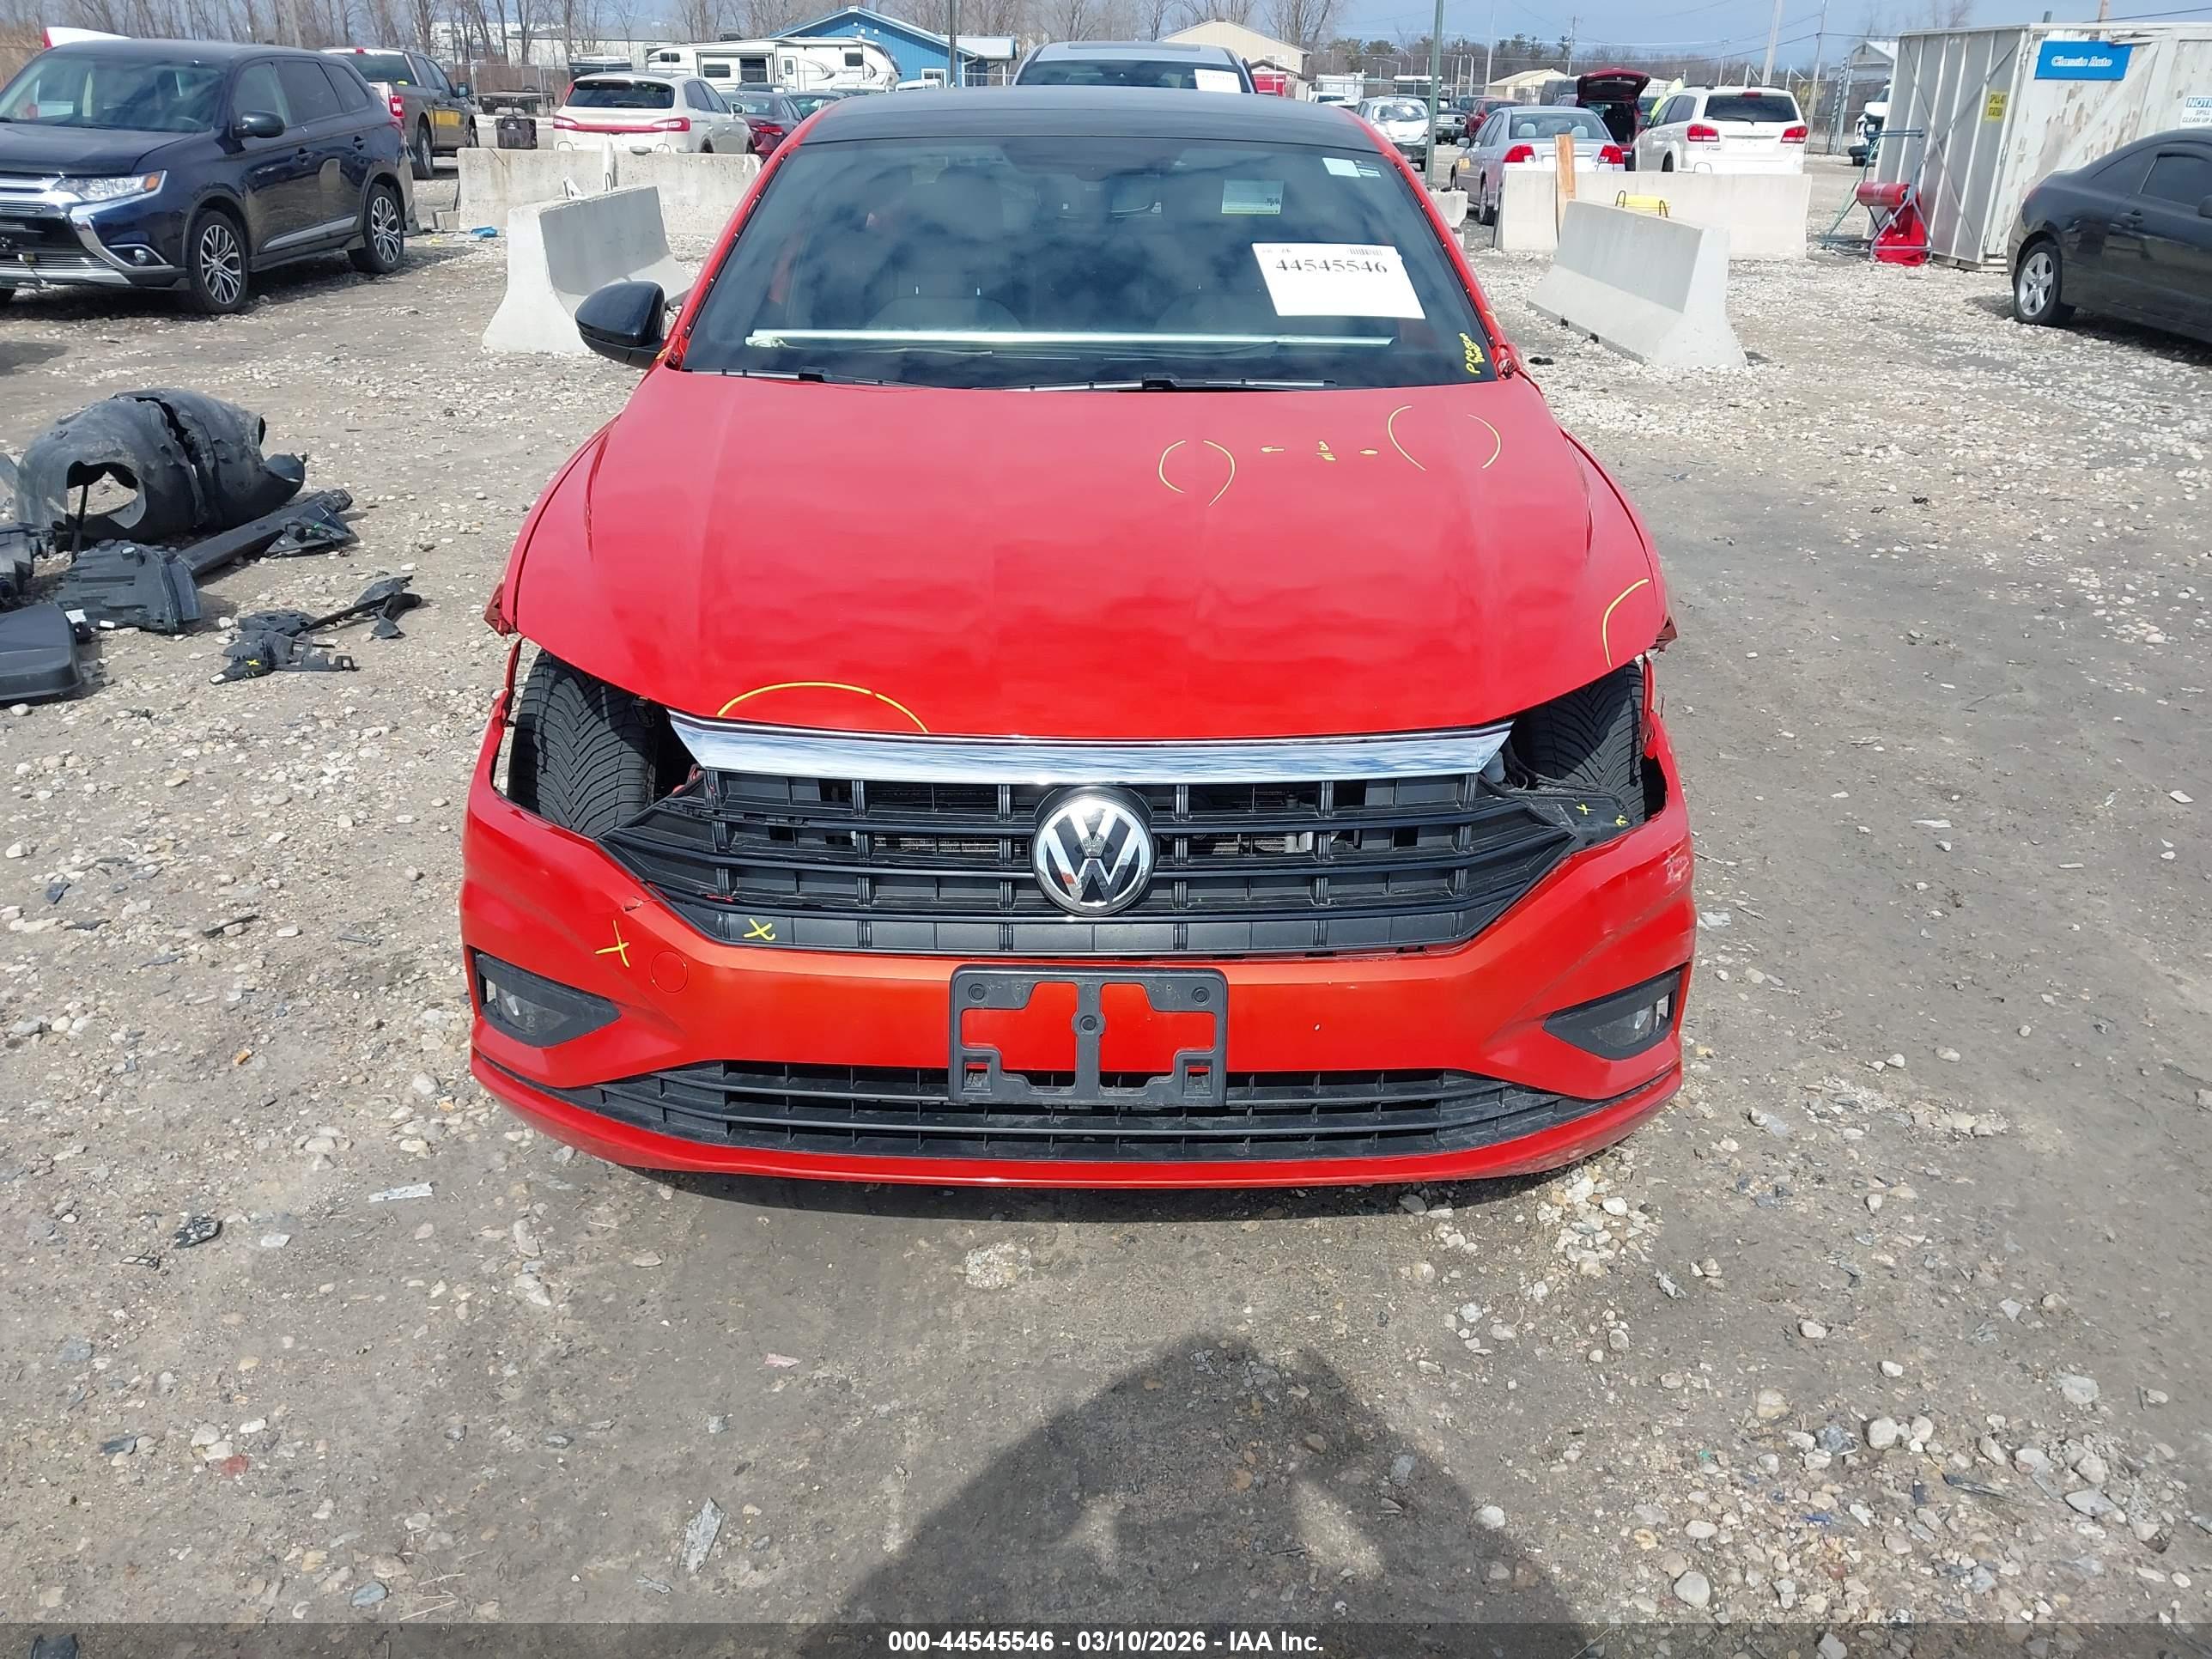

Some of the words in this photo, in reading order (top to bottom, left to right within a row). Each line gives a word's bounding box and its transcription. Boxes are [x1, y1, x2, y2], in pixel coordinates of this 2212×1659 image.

[2088, 56, 2112, 67] Auto
[1275, 258, 1389, 274] 44545546
[1033, 793, 1154, 916] VW
